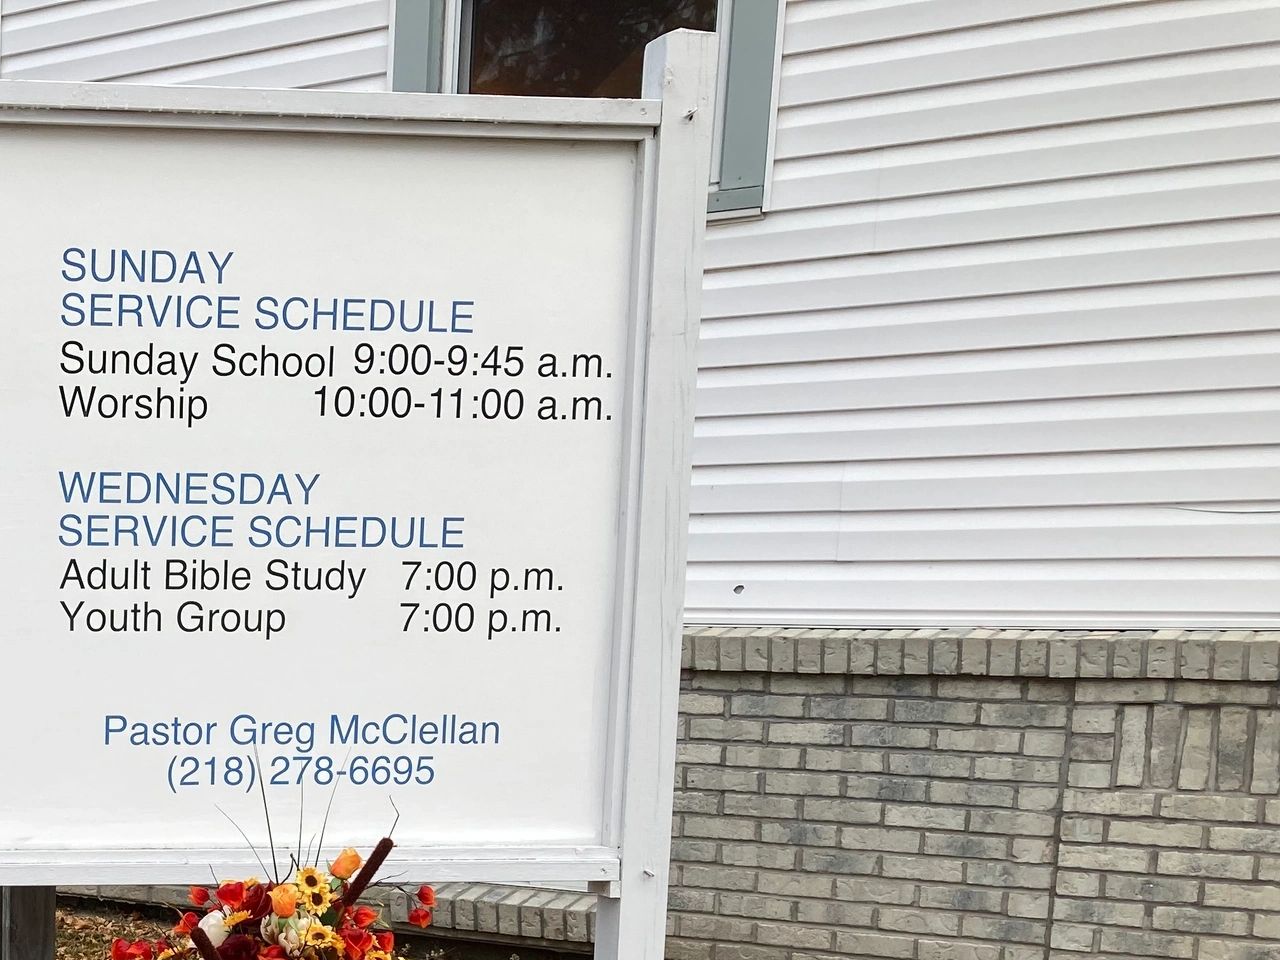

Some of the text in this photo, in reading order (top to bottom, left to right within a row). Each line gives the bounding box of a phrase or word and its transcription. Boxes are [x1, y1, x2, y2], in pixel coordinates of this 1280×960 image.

[61, 247, 234, 284] SUNDAY
[60, 292, 475, 334] SERVICE SCHEDULE
[58, 340, 612, 385] Sunday School 9:00-9:45 a.m.
[58, 385, 612, 428] Worship 10:00-11:00 a.m.
[58, 471, 321, 506] WEDNESDAY
[58, 513, 465, 549] SERVICE SCHEDULE
[59, 558, 564, 600] Adult Bible Study 7:00 p.m.
[59, 600, 562, 641] Youth Group 7:00 p.m.
[104, 713, 500, 754] Pastor Greg McClellan
[167, 755, 435, 794] (218) 278-6695
